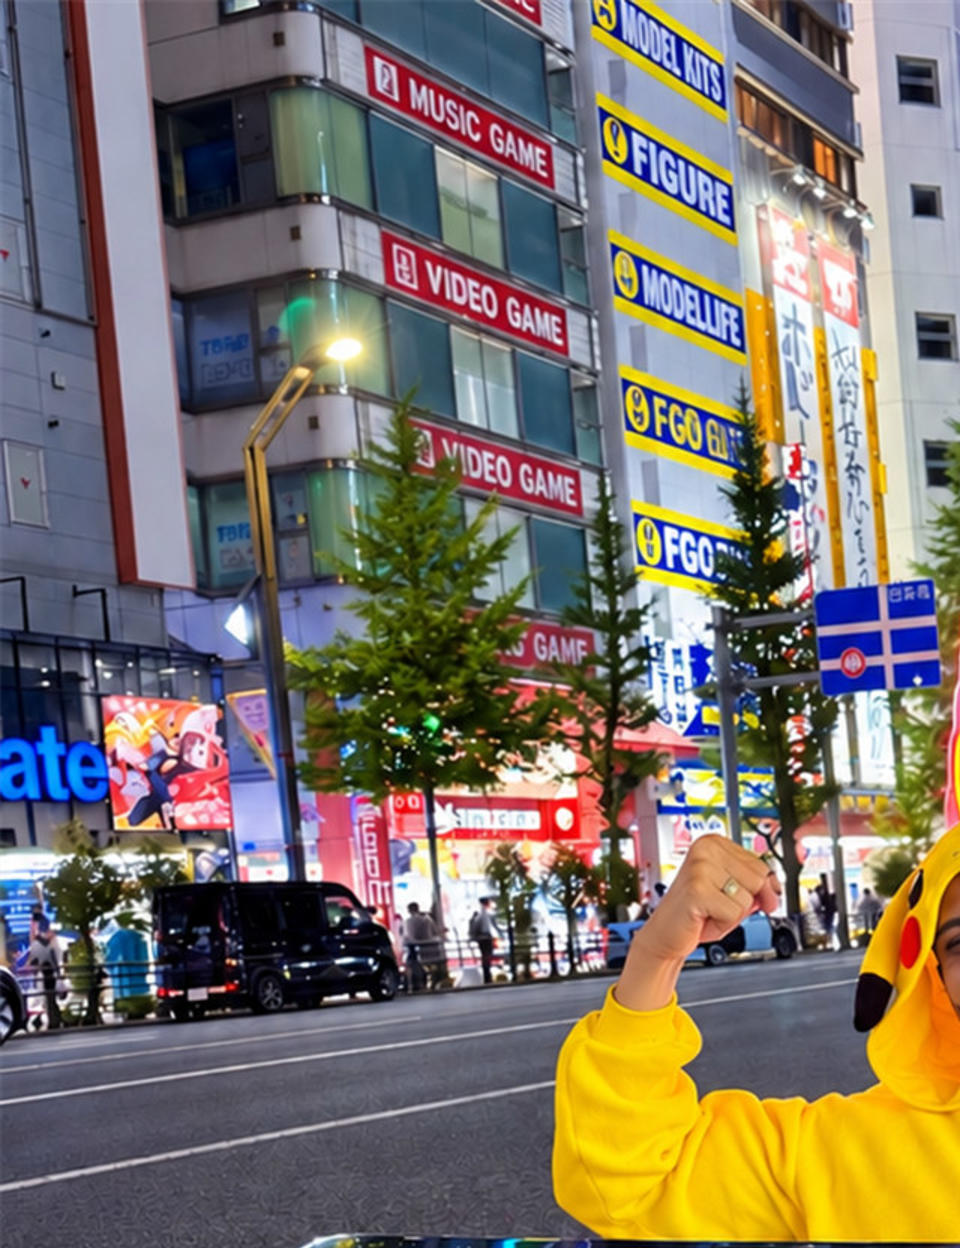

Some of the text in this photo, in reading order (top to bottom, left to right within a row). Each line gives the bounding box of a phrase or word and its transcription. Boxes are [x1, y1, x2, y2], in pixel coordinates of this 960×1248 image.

[621, 0, 722, 102] MODEL KITS
[408, 77, 549, 179] MUSIC GAME
[631, 130, 732, 226] FIGURE
[424, 259, 564, 346] VIDEO GAME
[652, 394, 702, 451] FGO
[441, 437, 578, 507] VIDEO GAME
[663, 524, 715, 579] FGO
[0, 725, 110, 803] ate
